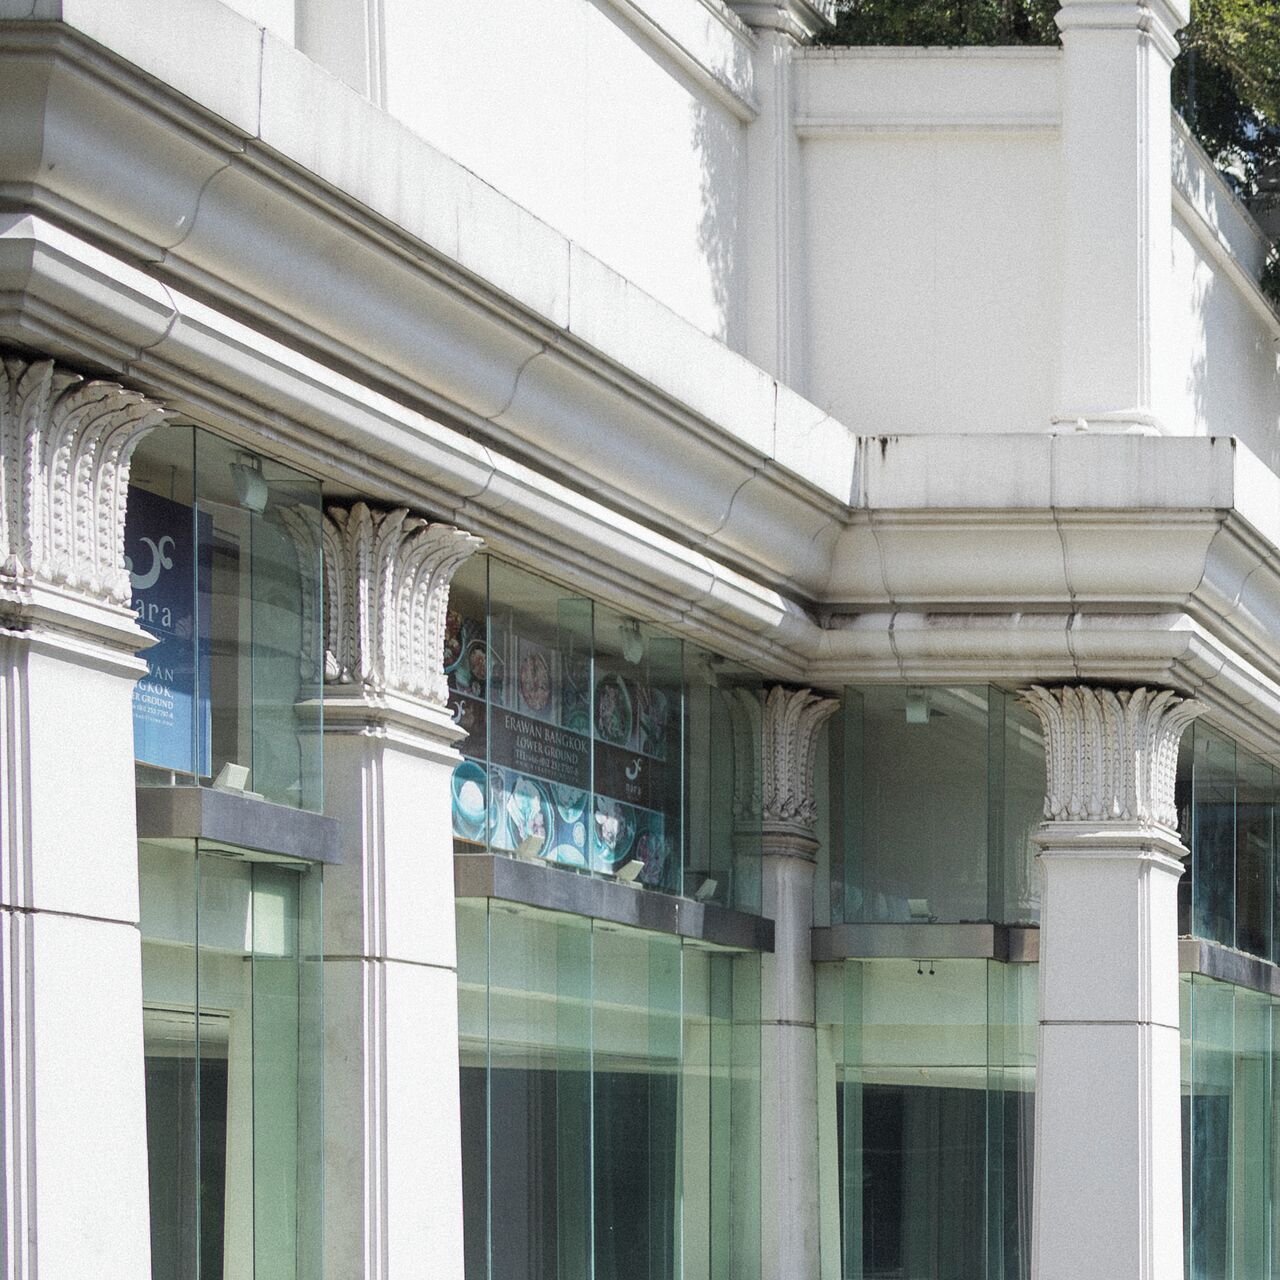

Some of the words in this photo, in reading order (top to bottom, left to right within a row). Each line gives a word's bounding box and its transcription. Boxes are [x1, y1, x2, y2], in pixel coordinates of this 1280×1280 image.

[135, 598, 172, 628] ara
[504, 715, 544, 739] ERAWAN
[544, 729, 588, 754] BANGKOK
[516, 735, 545, 755] LOWER
[544, 745, 578, 766] GROUND
